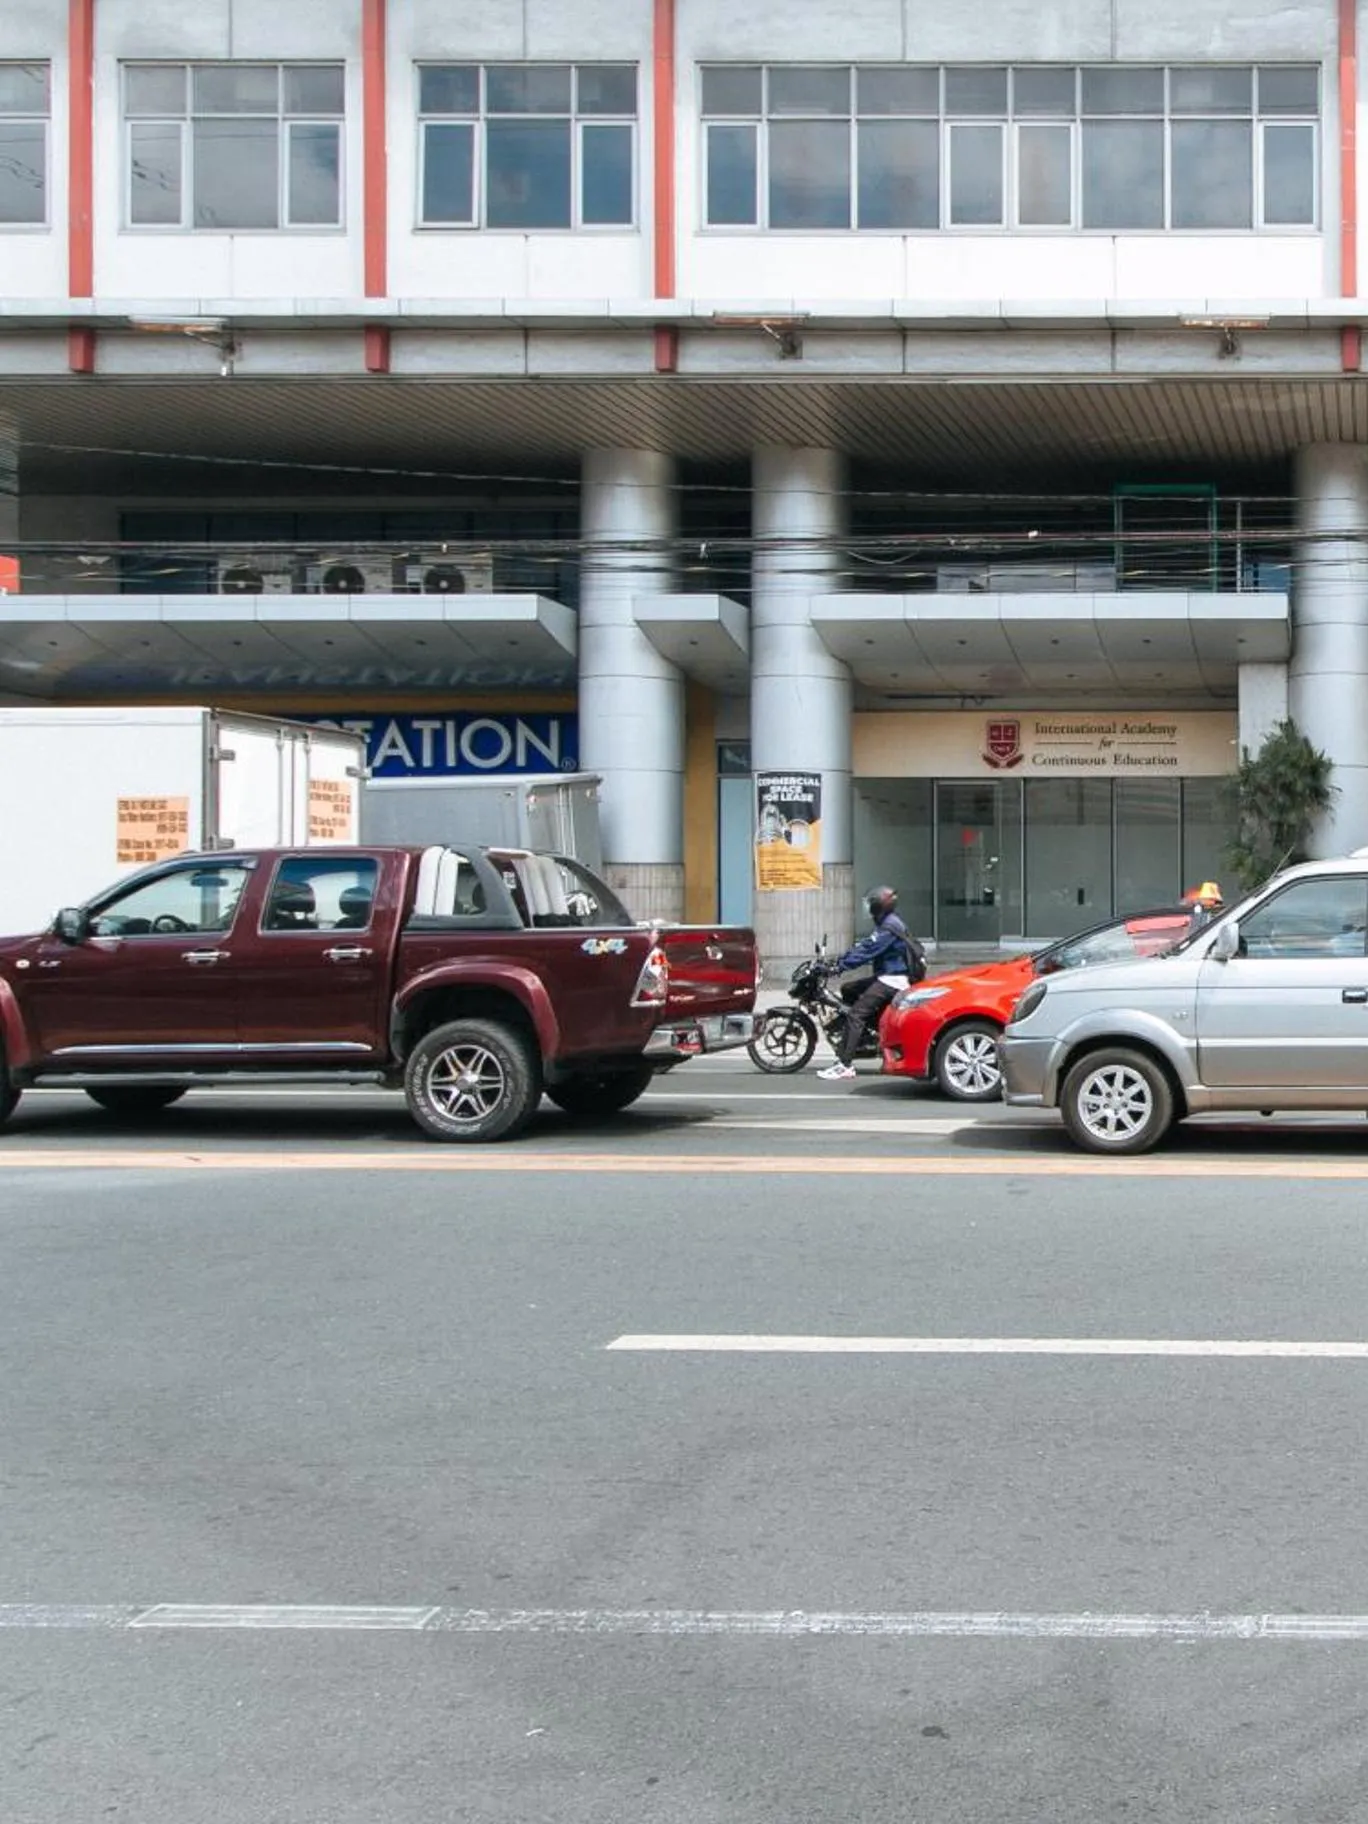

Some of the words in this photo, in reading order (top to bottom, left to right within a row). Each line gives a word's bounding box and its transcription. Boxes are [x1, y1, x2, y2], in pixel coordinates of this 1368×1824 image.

[1035, 721, 1116, 735] International
[1121, 722, 1177, 737] Academy
[312, 718, 560, 769] ATION
[1098, 736, 1115, 751] for
[1032, 752, 1107, 767] Continuous
[1113, 752, 1178, 767] Education
